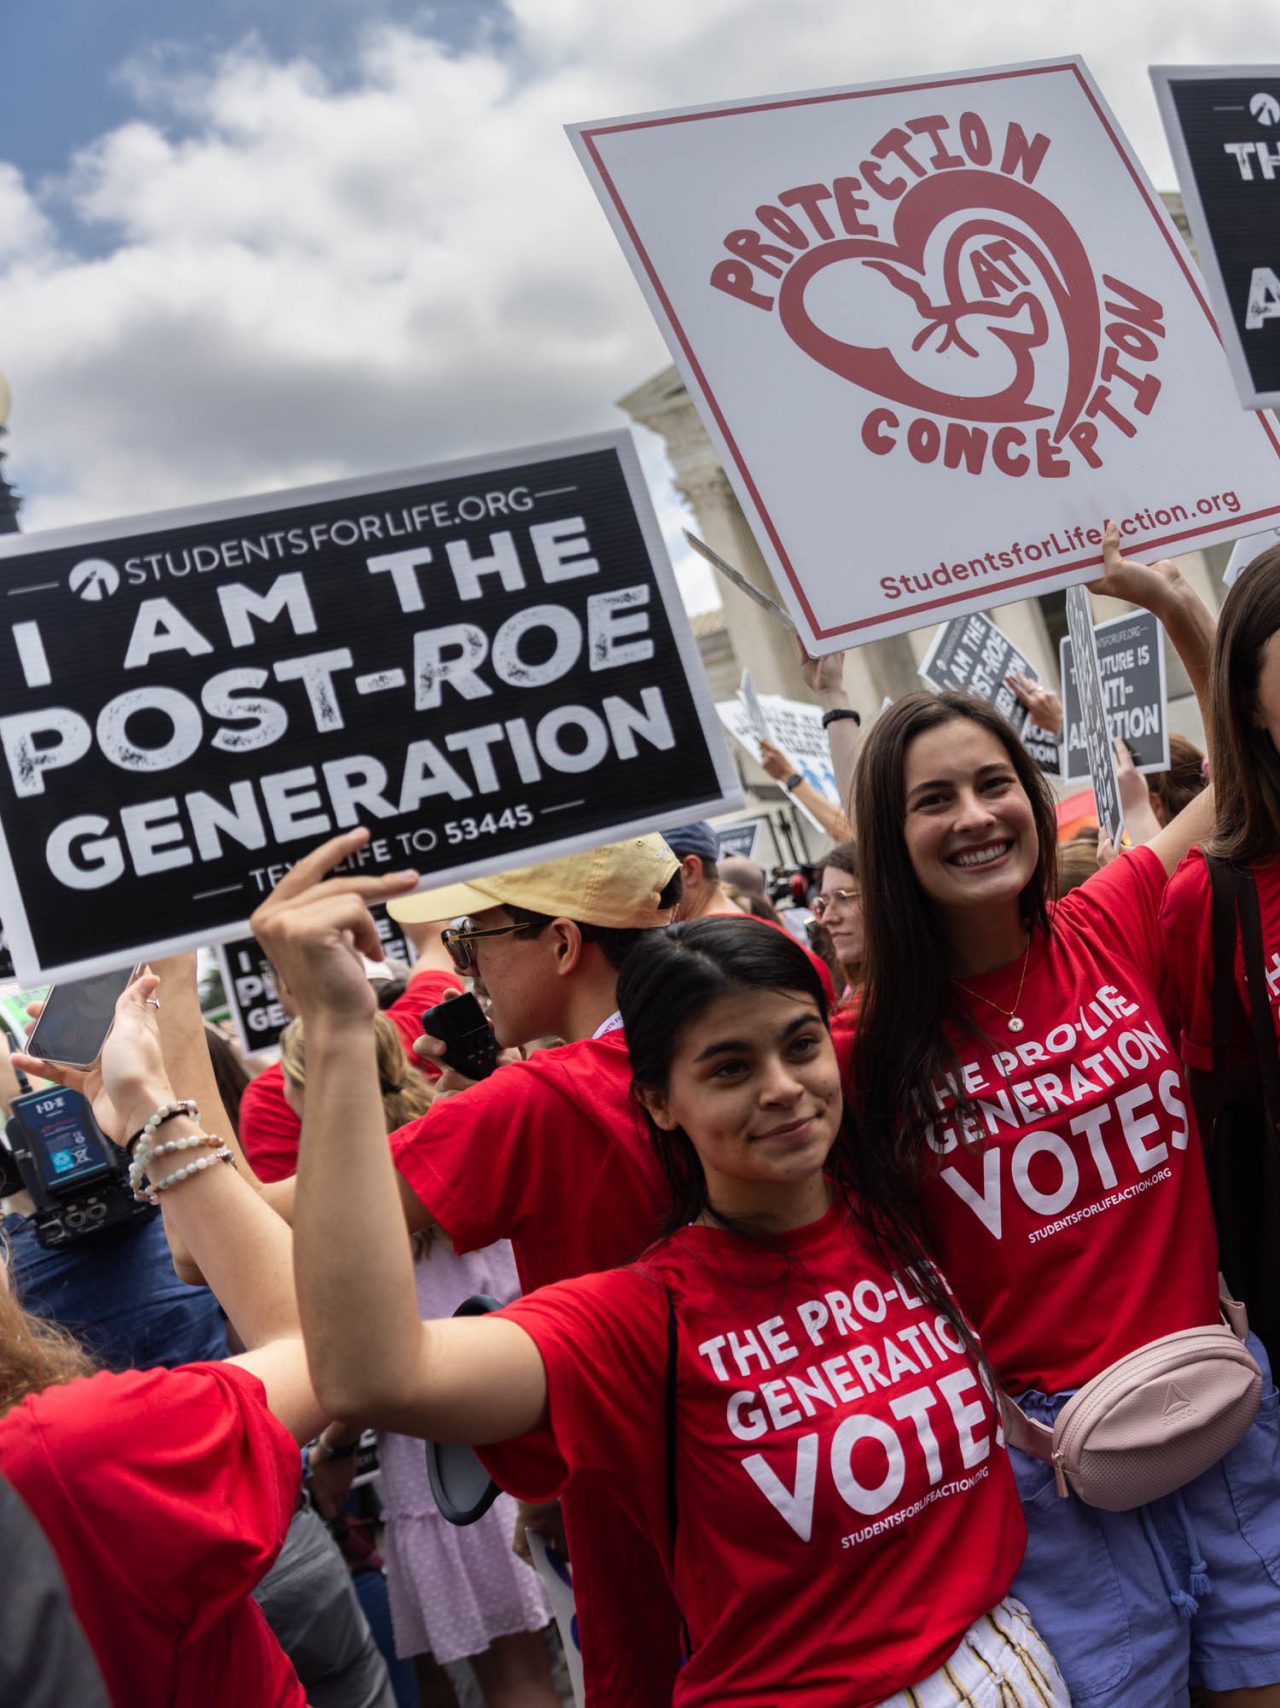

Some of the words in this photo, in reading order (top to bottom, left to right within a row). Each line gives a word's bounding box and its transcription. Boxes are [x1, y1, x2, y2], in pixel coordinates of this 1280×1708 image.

[710, 111, 1051, 311] PROTECTION
[970, 240, 1032, 298] AT
[861, 274, 1166, 479] CONCEPTION
[125, 486, 534, 584] STUDENTSFORLIFE.ORG
[12, 621, 52, 688] I
[123, 571, 318, 670] AM
[366, 516, 599, 613] THE
[961, 615, 988, 651] THE
[2, 584, 655, 798] POST-ROE
[950, 648, 974, 685] AM
[1100, 648, 1135, 677] UTURE
[1138, 644, 1150, 666] IS
[1102, 676, 1134, 710] NTI-
[1067, 703, 1160, 752] ABRTION
[46, 687, 677, 891] GENERATION
[396, 828, 437, 855] TO
[444, 805, 534, 844] 53445
[992, 985, 1140, 1077] PRO-LIFE
[926, 1021, 1169, 1154] GENERATION
[940, 1069, 1189, 1240] VOTES
[1028, 1167, 1172, 1243] STUDENTSFORLIFEACTION.ORG
[698, 1316, 799, 1382] THE
[726, 1314, 980, 1440] GENERATIO
[841, 1467, 989, 1549] STUDENTSFORLIFEACTION.ORG
